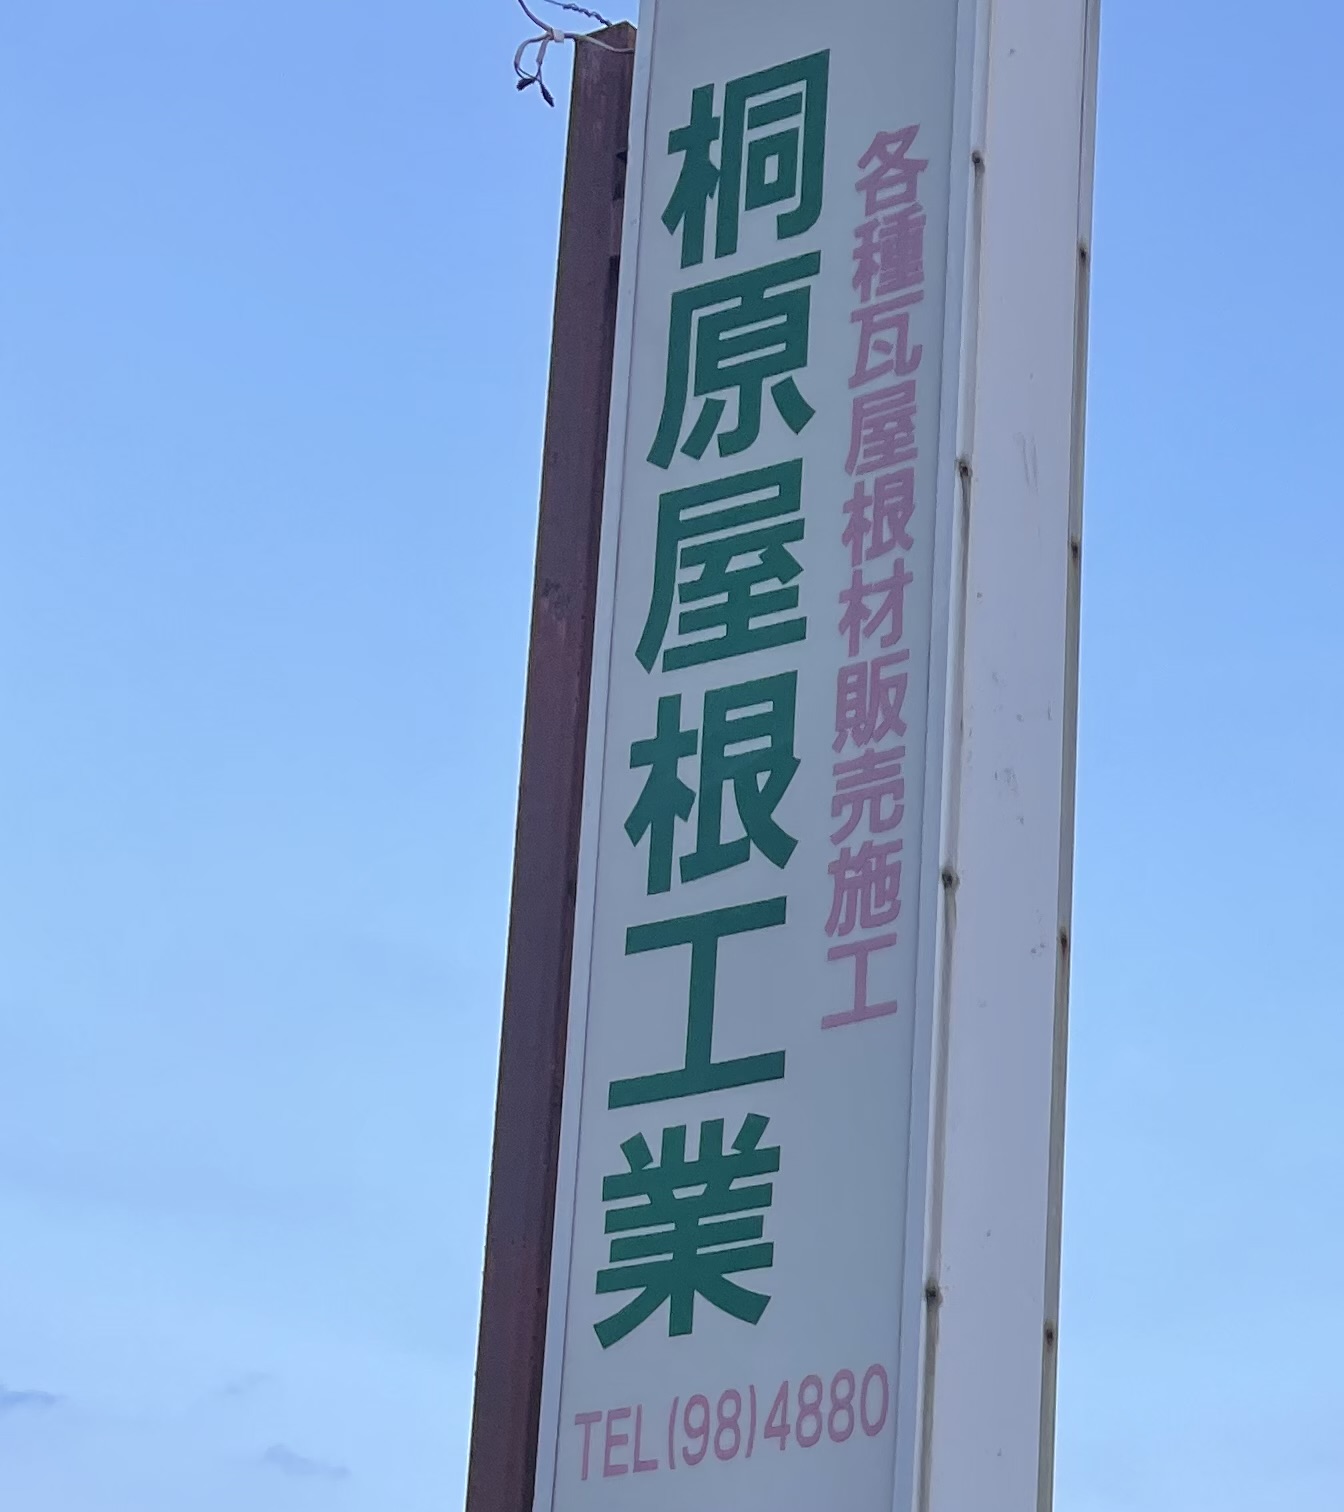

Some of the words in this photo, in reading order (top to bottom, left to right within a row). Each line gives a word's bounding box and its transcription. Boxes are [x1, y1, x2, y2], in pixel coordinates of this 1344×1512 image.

[593, 49, 830, 1348] 桐原屋根工業
[820, 124, 928, 1030] 各種瓦屋根材販売施工
